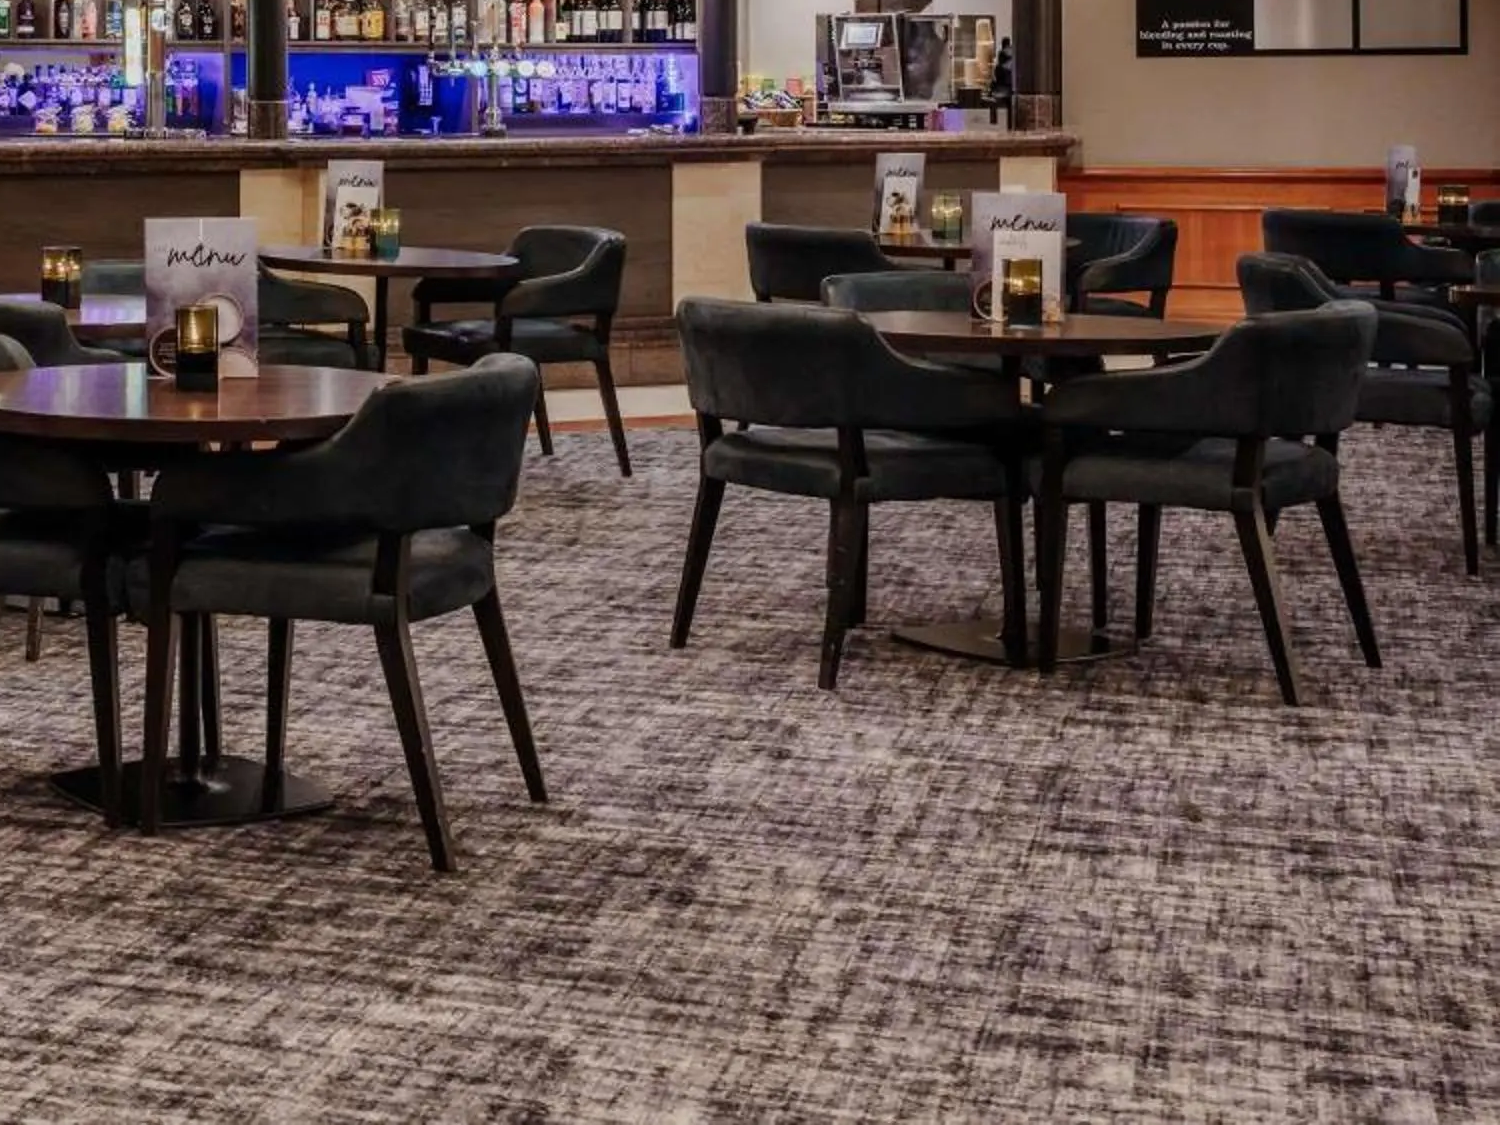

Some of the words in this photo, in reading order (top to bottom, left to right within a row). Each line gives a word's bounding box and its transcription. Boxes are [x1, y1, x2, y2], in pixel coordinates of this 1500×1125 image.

[1161, 19, 1169, 29] A
[1214, 19, 1230, 28] for
[1140, 30, 1185, 41] blending
[1187, 30, 1207, 38] and
[1209, 29, 1252, 40] roasting
[1161, 42, 1173, 50] in
[1175, 42, 1205, 51] every
[990, 214, 1059, 231] menu
[167, 243, 247, 267] menu
